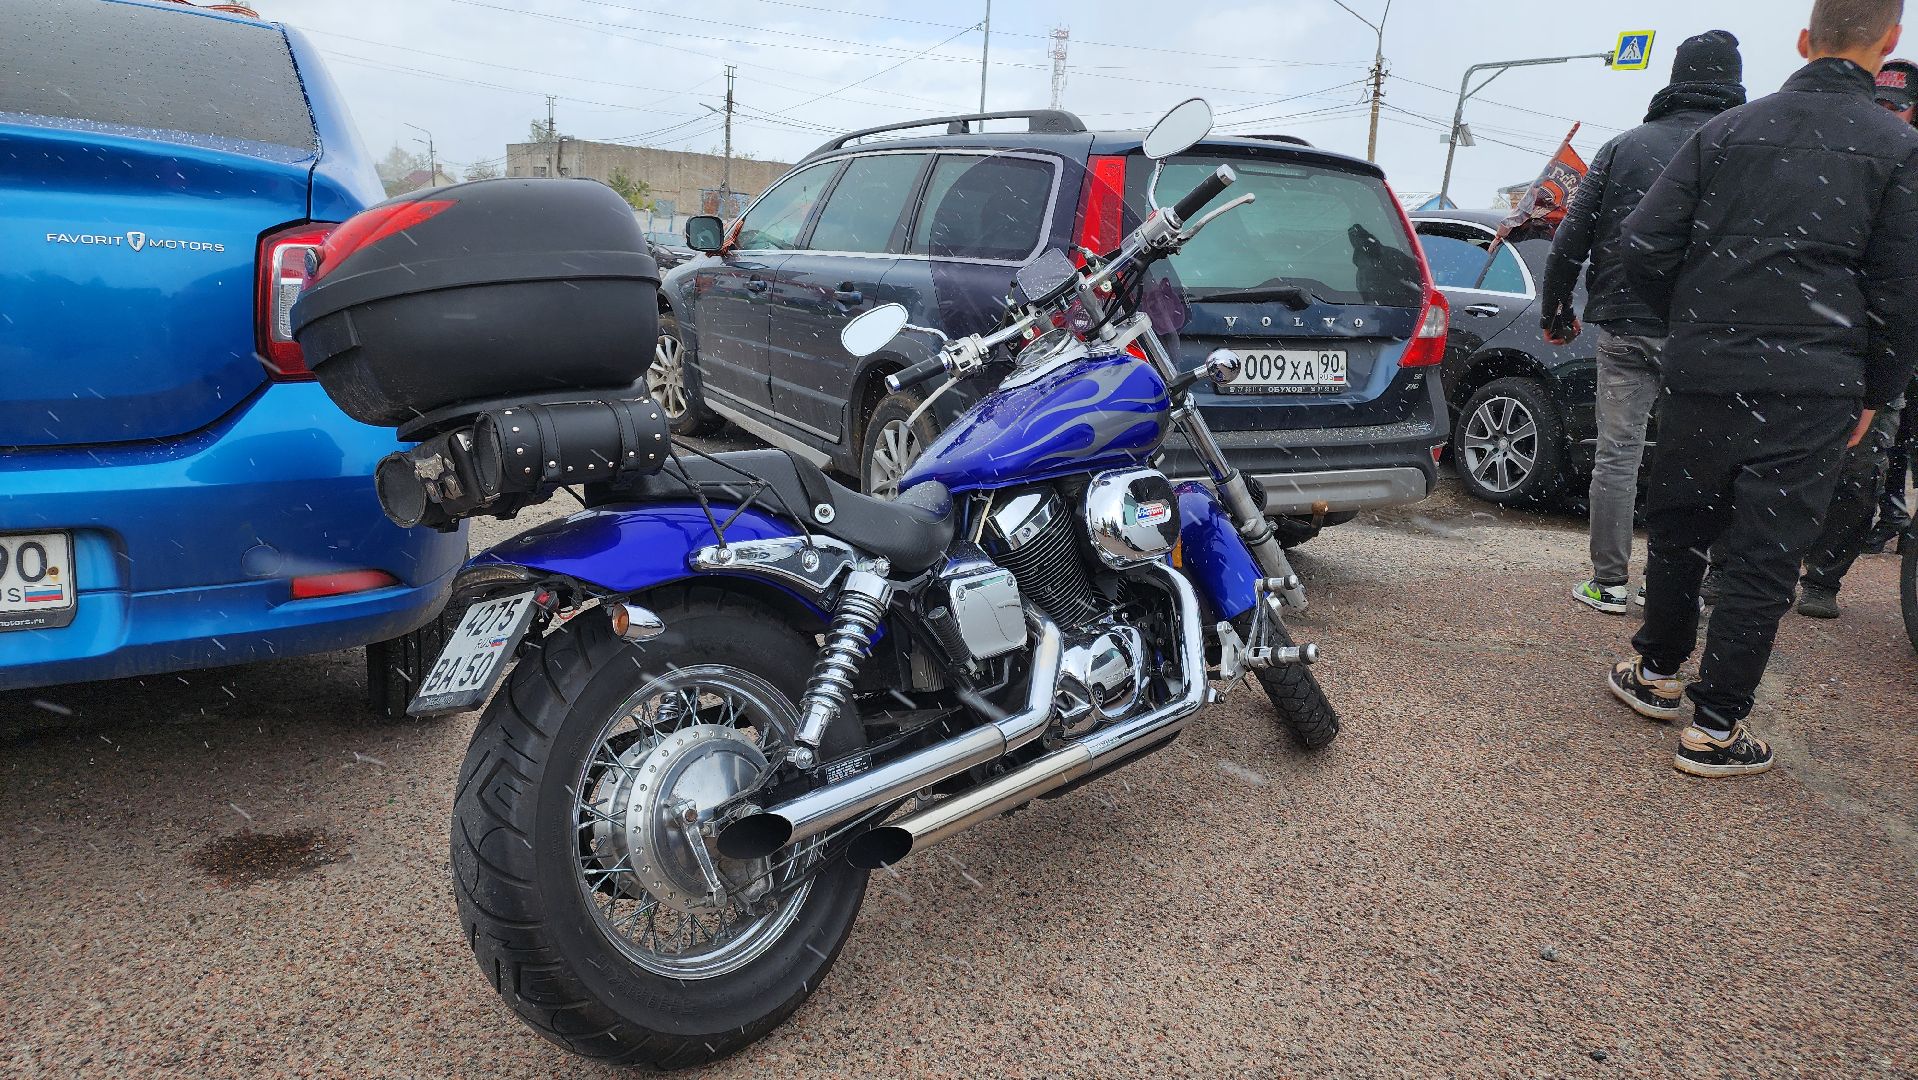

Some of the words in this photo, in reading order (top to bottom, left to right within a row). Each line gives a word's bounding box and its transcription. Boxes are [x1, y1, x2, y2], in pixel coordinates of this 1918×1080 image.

[46, 233, 123, 247] FAVORIT
[149, 239, 225, 252] MOTORS
[1223, 316, 1364, 328] VOLVO
[1320, 353, 1340, 373] 90
[1320, 373, 1334, 381] RUS
[0, 541, 48, 583] 0
[465, 597, 524, 638] 4275
[474, 637, 495, 650] RUS
[458, 651, 495, 687] 50
